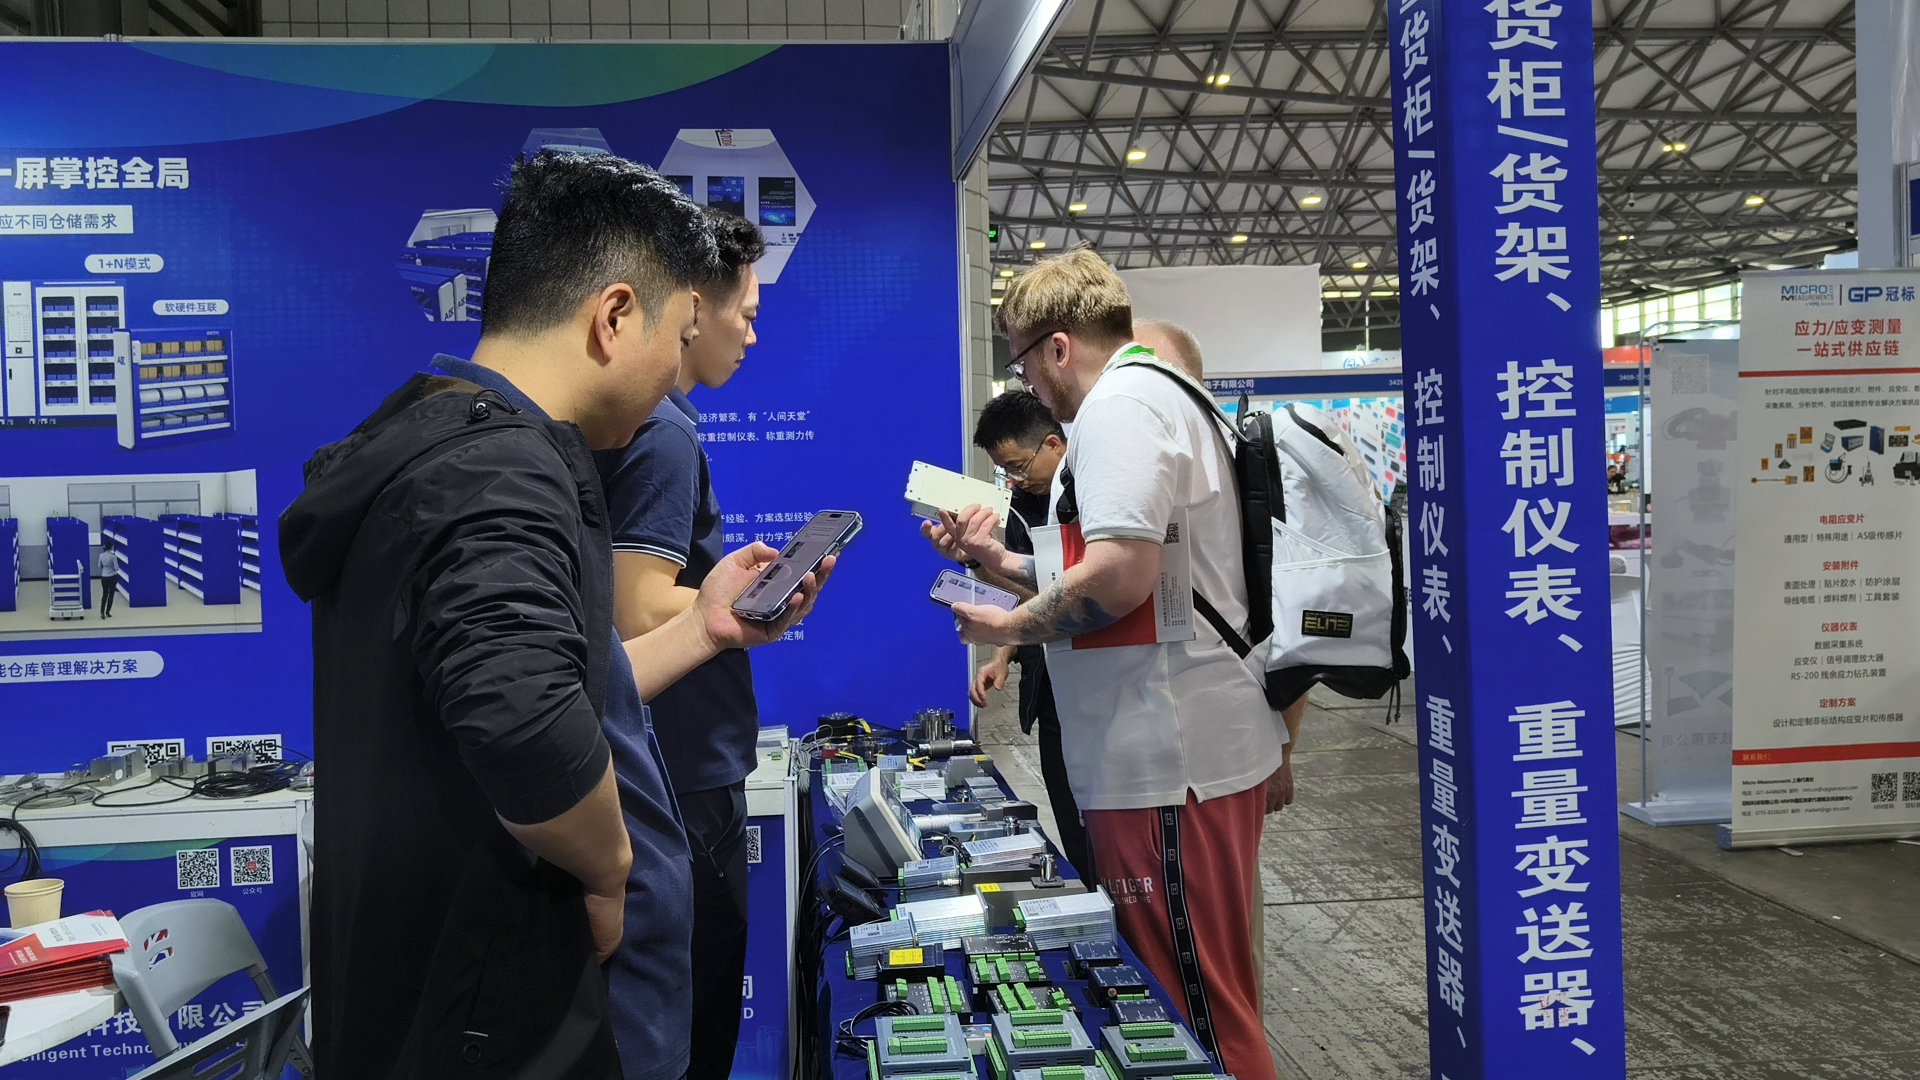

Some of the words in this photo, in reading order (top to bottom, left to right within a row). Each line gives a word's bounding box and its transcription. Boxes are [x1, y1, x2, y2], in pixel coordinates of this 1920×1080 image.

[98, 257, 151, 270] 1+N模式
[1781, 285, 1828, 295] MICRO
[1847, 286, 1883, 302] GP
[1885, 286, 1916, 302] 冠标
[165, 302, 218, 312] 软硬件互联
[1795, 318, 1902, 337] 应力/应变测量
[1797, 340, 1900, 357] 一站式供应链
[1203, 379, 1255, 389] 电子有限公司
[721, 511, 814, 524] 经验、方案选型经验
[1819, 513, 1865, 525] 电阻应变片
[1783, 534, 1808, 544] 通用型
[1816, 532, 1849, 542] 特殊用途
[1857, 530, 1903, 541] AS级传感片
[1822, 560, 1859, 571] 安装附件
[1783, 580, 1816, 590] 表面处理
[1824, 578, 1857, 589] 贴片胶水
[1865, 577, 1901, 587] 防护涂层
[1783, 595, 1816, 605] 导线电缆
[1865, 592, 1900, 602] 工具套装
[1821, 622, 1858, 632] 仪器仪表
[778, 630, 804, 641] 定制
[1814, 639, 1863, 650] 数据采集系统
[1794, 656, 1818, 666] 应变仪
[1826, 653, 1884, 665] 信号调理放大器
[1790, 671, 1819, 681] RS-200
[1820, 668, 1887, 680] 残余应力钻孔装置
[1819, 697, 1857, 708] 定制方案
[1772, 713, 1904, 729] 设计和定制非标结构应变片和传感器
[190, 890, 204, 898] 官网
[242, 887, 263, 895] 公众号
